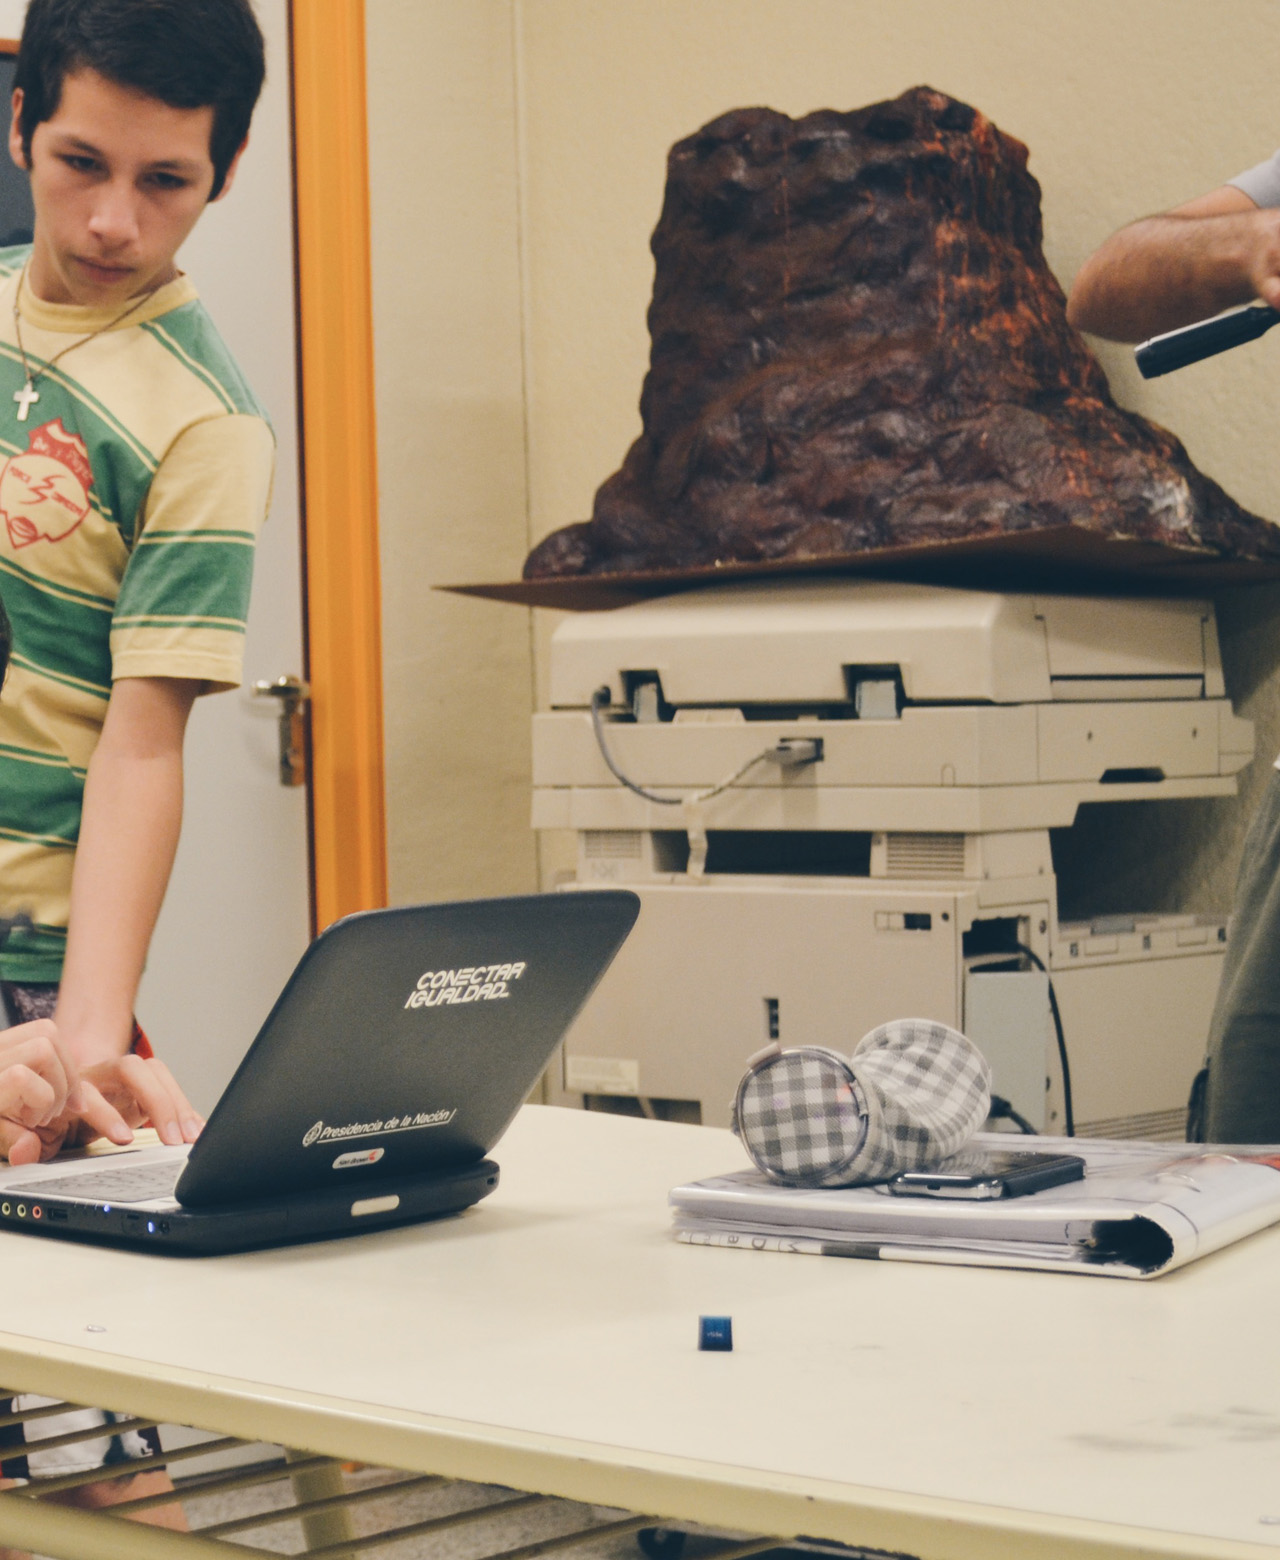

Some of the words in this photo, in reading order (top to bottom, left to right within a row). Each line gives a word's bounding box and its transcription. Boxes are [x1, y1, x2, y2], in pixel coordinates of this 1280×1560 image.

[417, 961, 527, 991] CONECTAR
[320, 1120, 382, 1138] Presidencia
[384, 1116, 399, 1129] de
[401, 1115, 411, 1126] la
[413, 1110, 450, 1124] Nación
